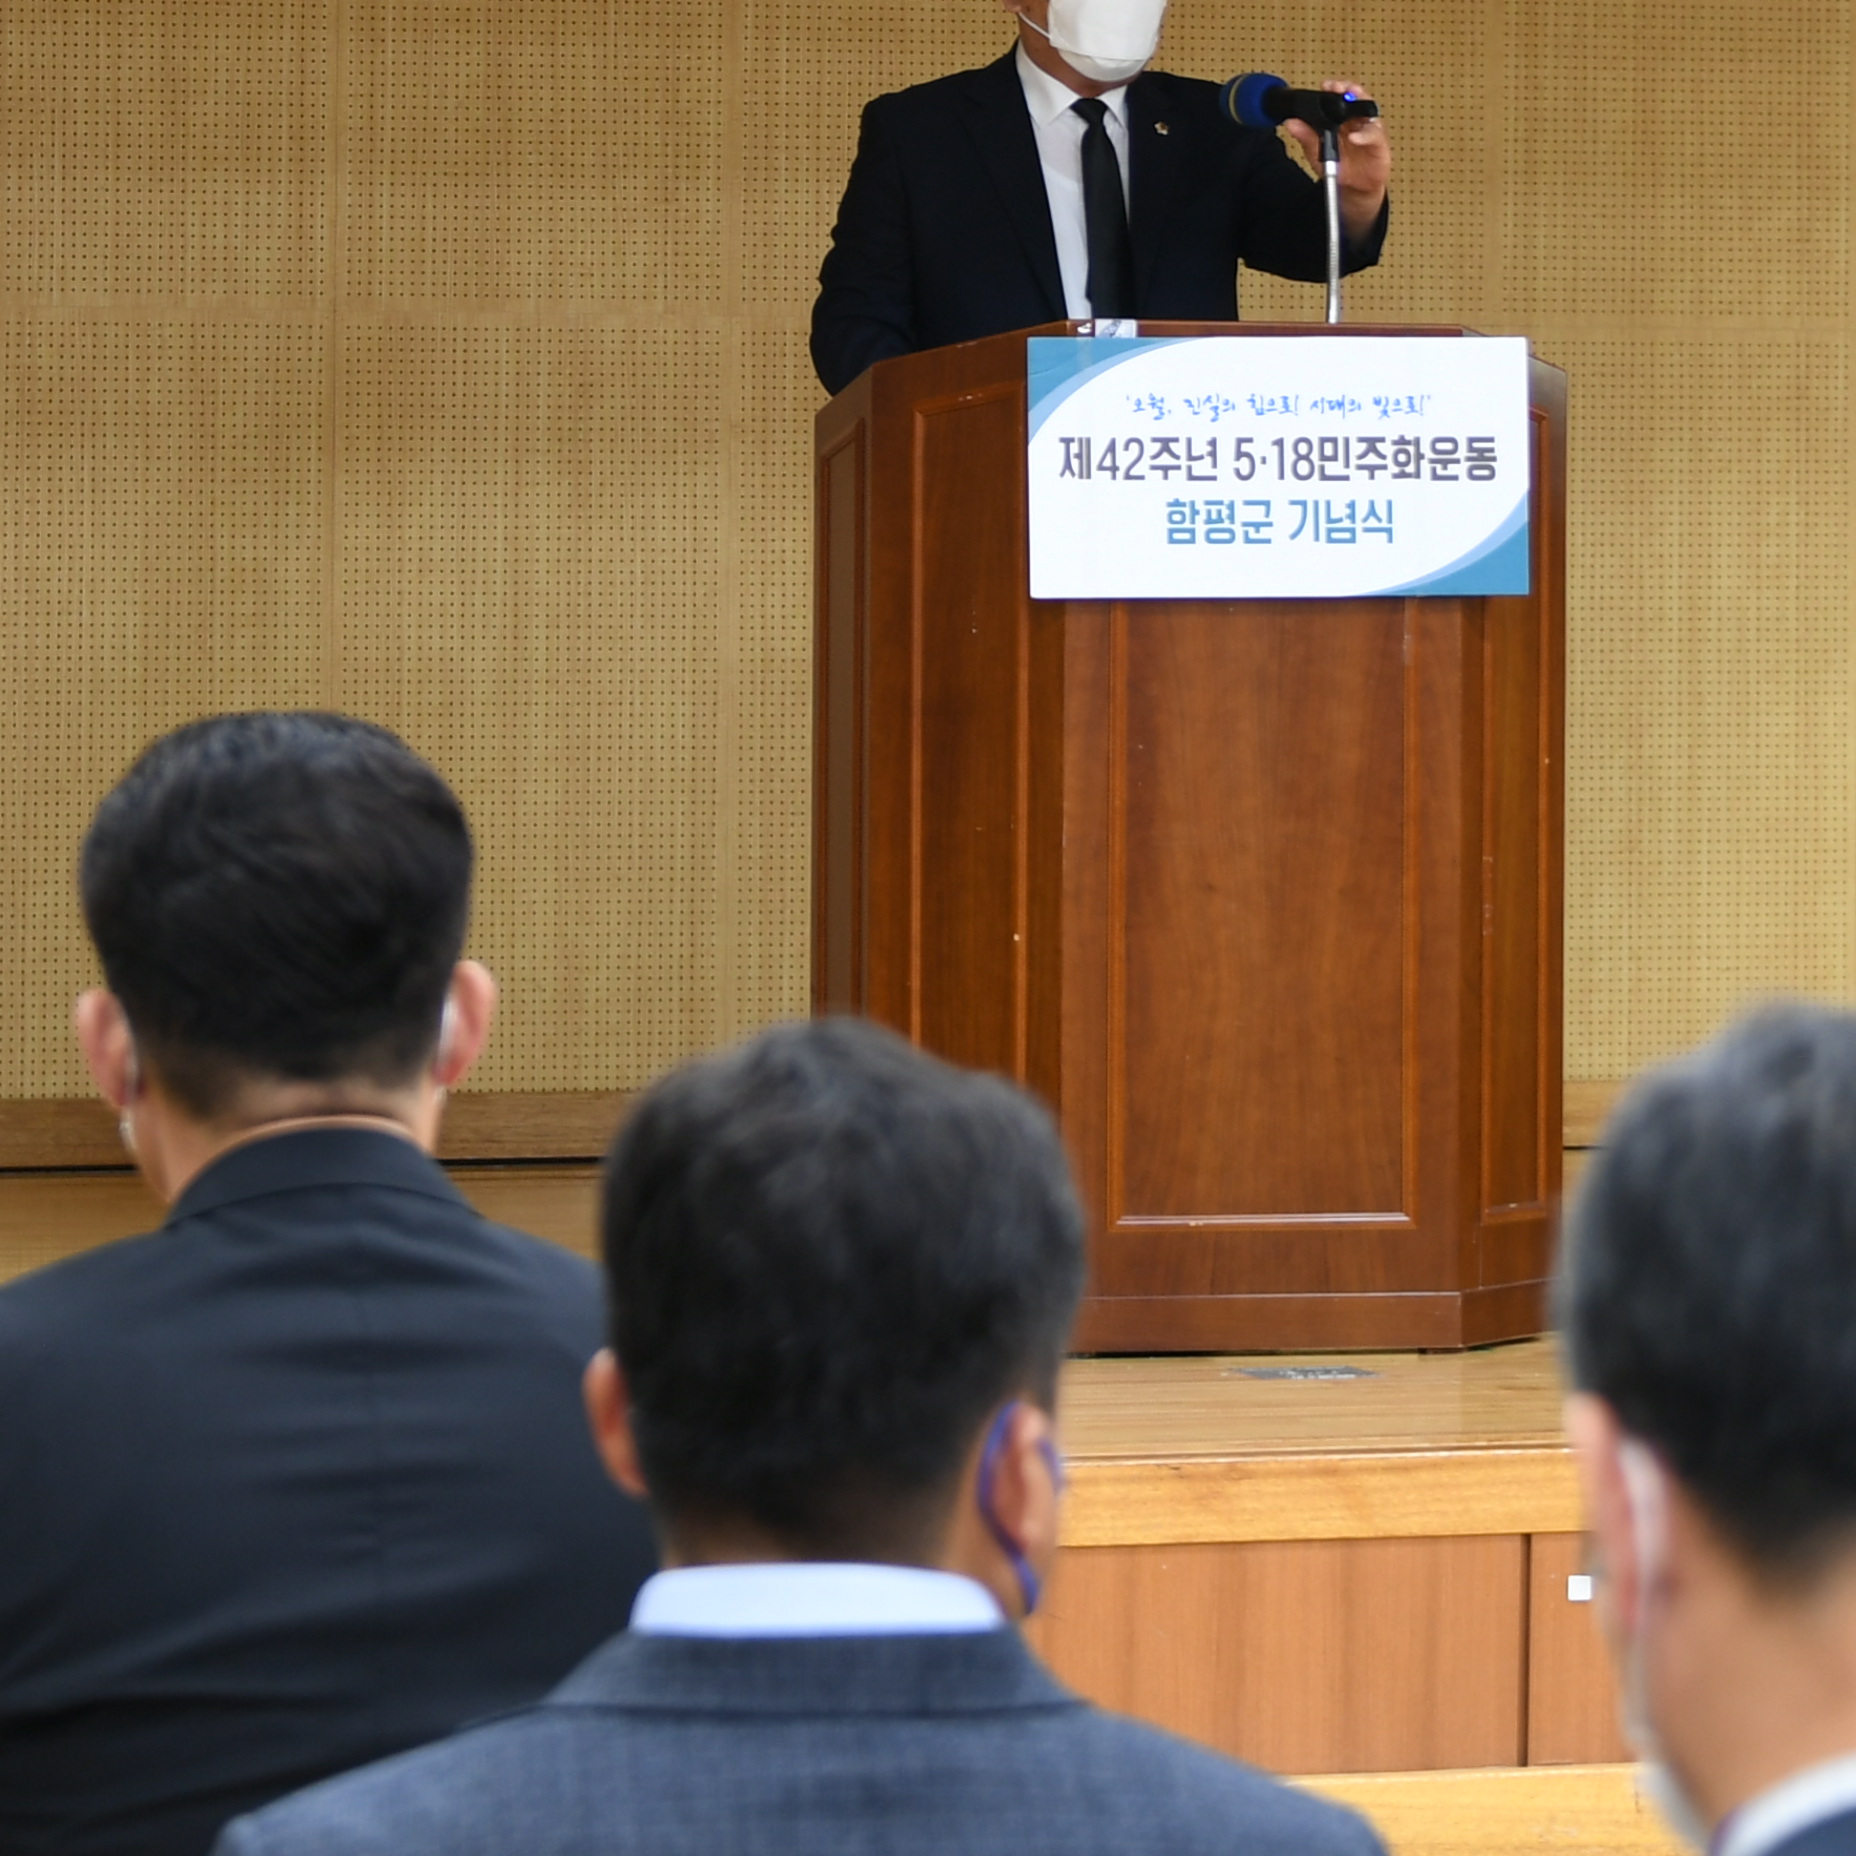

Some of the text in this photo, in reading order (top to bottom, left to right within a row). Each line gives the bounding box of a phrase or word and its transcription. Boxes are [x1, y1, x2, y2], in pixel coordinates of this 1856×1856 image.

[1058, 434, 1499, 482] 제42주년 5·18민주화운동
[1165, 497, 1395, 545] 함평군 기념식
